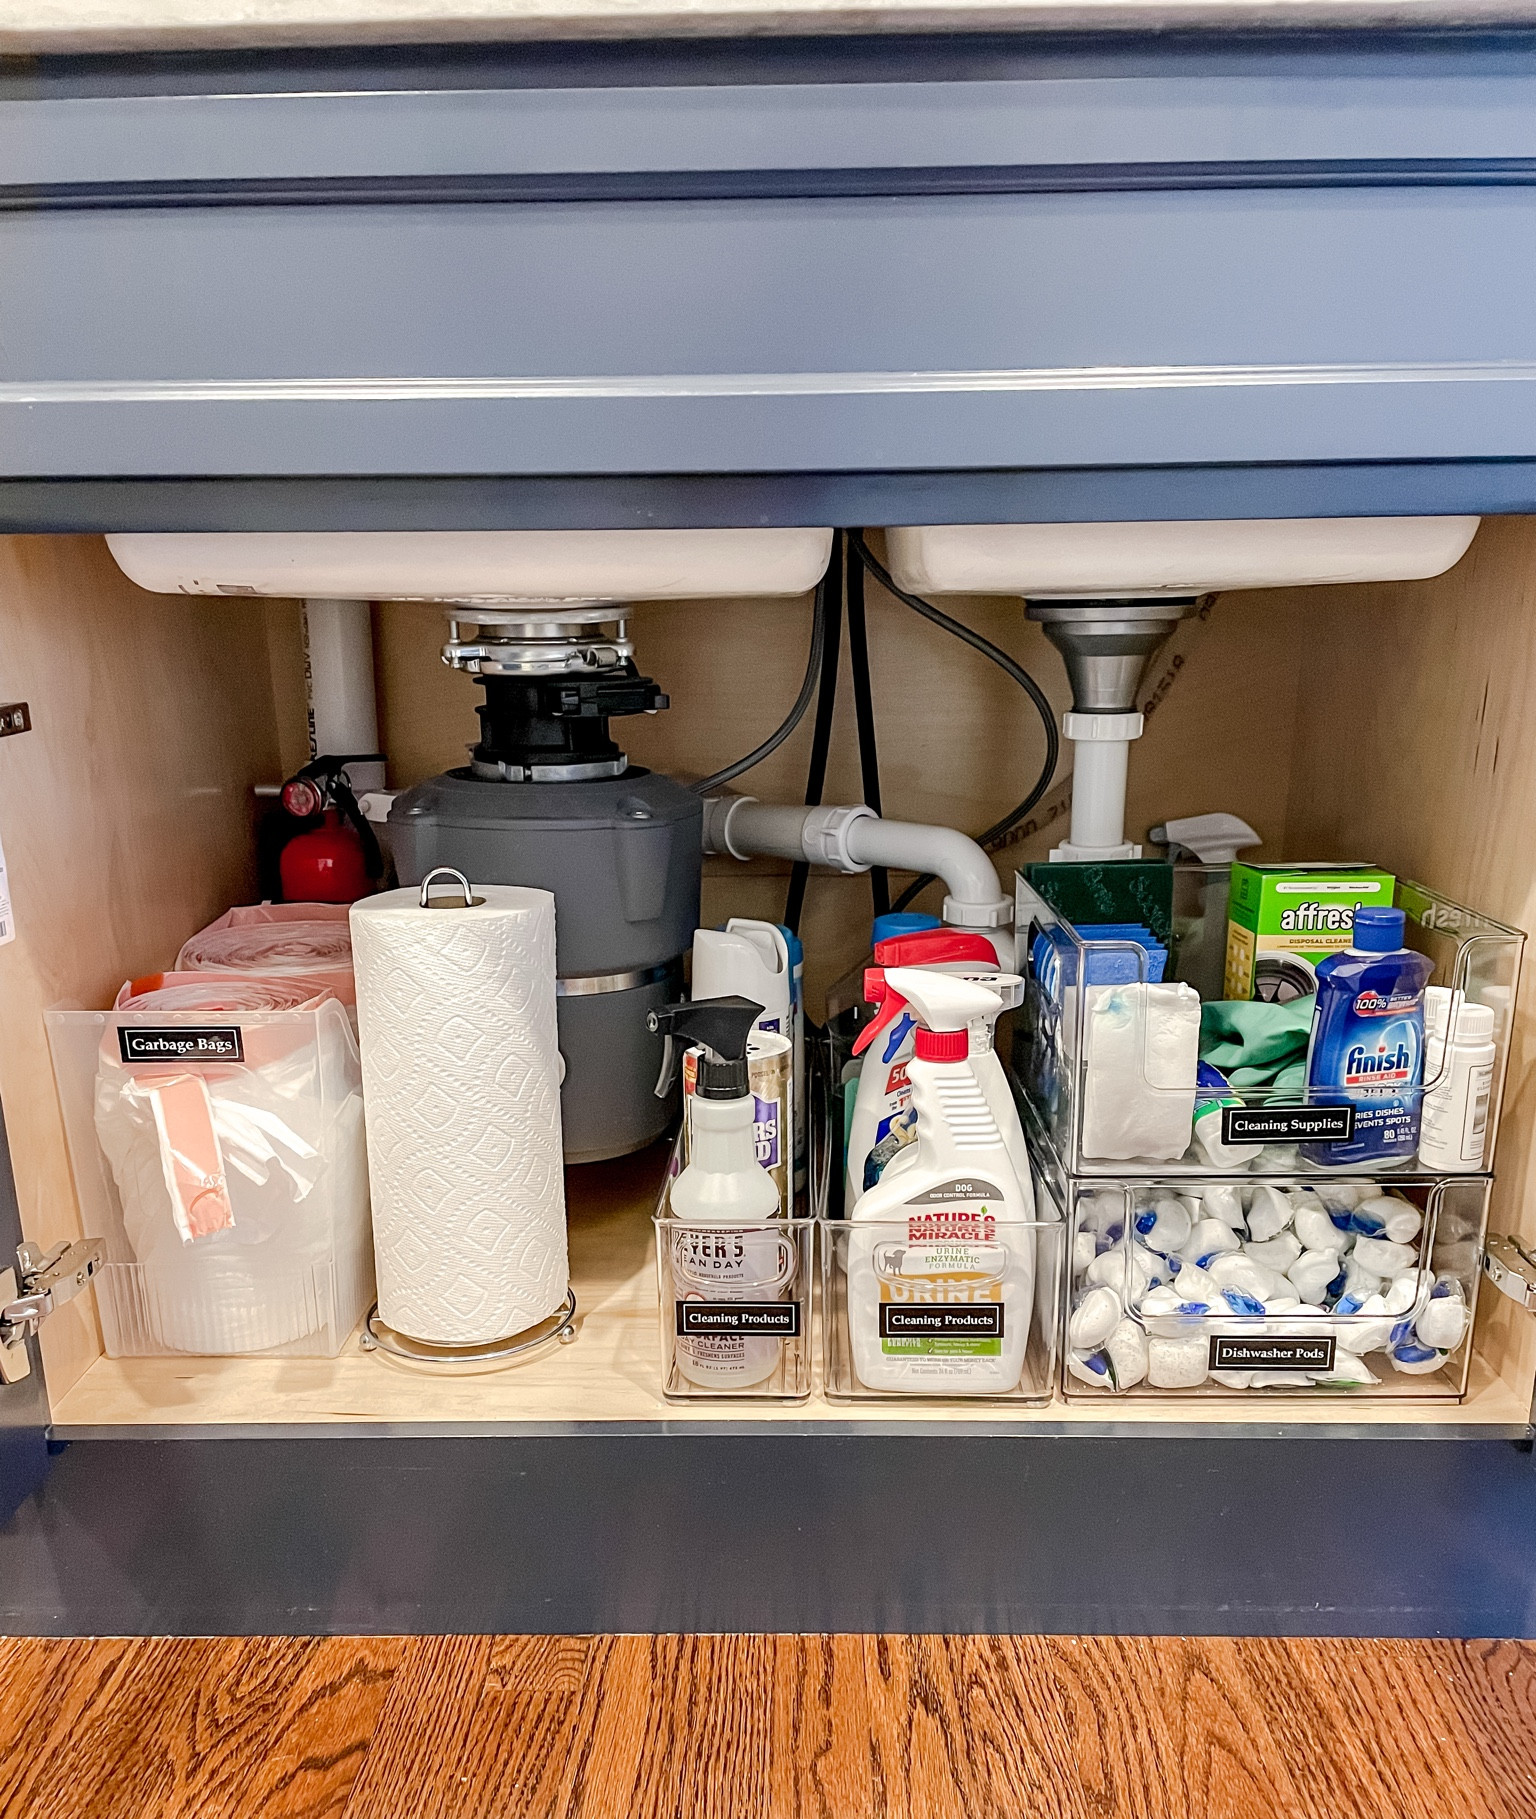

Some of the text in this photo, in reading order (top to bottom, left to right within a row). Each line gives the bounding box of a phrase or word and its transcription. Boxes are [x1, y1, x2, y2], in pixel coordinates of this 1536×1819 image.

[303, 652, 312, 679] DWV
[1280, 902, 1363, 931] affres
[1356, 998, 1387, 1010] 100%
[132, 1038, 233, 1053] Garbage Bags
[1346, 1042, 1411, 1075] finish
[1354, 1107, 1404, 1119] RIES DISHES
[1235, 1118, 1344, 1132] Cleaning Supplies
[1354, 1119, 1384, 1130] EVENTS
[1385, 1116, 1411, 1125] SPOTS
[1384, 1130, 1395, 1139] 80
[955, 1184, 973, 1192] DOG
[909, 1232, 996, 1241] MIRACLE
[713, 1260, 744, 1269] DAY
[924, 1255, 980, 1264] ENZYMATIC
[689, 1313, 790, 1325] Cleaning Products
[892, 1315, 994, 1327] Cleaning Products
[698, 1341, 745, 1350] CLEANER
[1222, 1347, 1325, 1359] Dishwasher Pods
